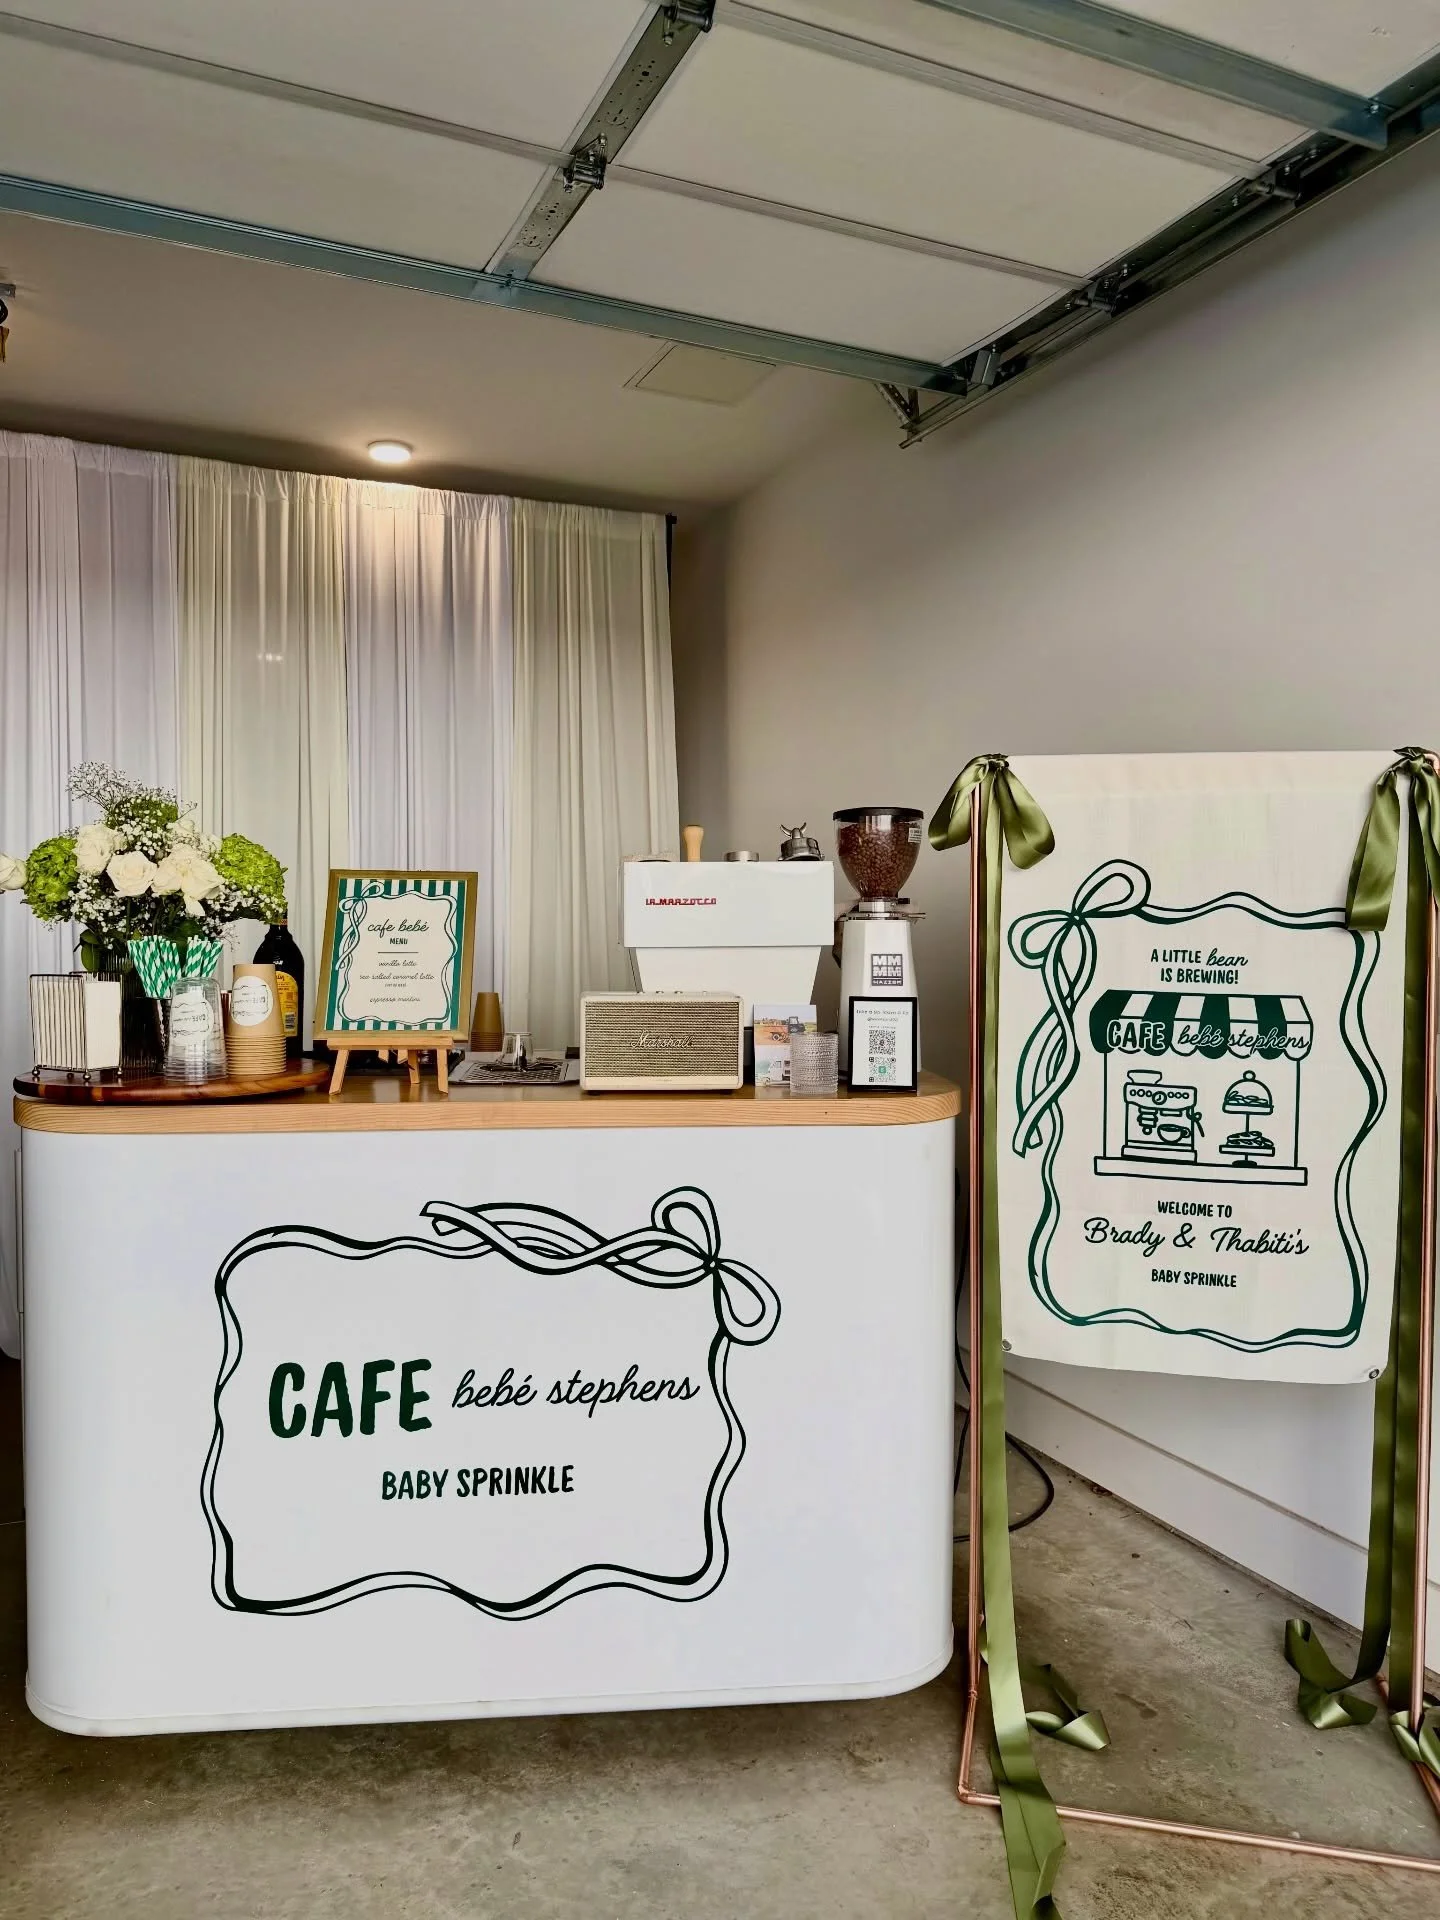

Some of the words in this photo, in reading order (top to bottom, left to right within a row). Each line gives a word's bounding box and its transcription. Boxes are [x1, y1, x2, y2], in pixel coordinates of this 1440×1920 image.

[367, 918, 396, 939] cafe
[397, 919, 430, 932] bebé
[389, 937, 409, 945] MENU
[378, 959, 400, 967] vanilla
[402, 959, 417, 967] latte
[1150, 948, 1159, 963] A
[1162, 949, 1202, 964] LITTLE
[1205, 947, 1249, 967] bean
[371, 972, 391, 980] salted
[392, 972, 418, 980] caramel
[419, 972, 435, 980] latte
[1160, 967, 1173, 983] IS
[1176, 967, 1239, 985] BREWING!
[629, 1030, 695, 1049] Marshall
[1108, 1020, 1165, 1049] CAFE
[1178, 1025, 1224, 1047] bebé
[1228, 1027, 1310, 1054] stephens
[1157, 1200, 1214, 1217] WELCOME
[1216, 1204, 1233, 1219] TO
[1083, 1216, 1166, 1258] Brady
[1172, 1222, 1196, 1249] &
[1210, 1226, 1310, 1255] Thabiti's
[1151, 1268, 1182, 1284] BABY
[1183, 1271, 1237, 1288] SPRINKLE
[268, 1358, 433, 1439] CAFE
[451, 1367, 538, 1409] bebé
[545, 1363, 701, 1419] stephens
[381, 1468, 449, 1501] BABY
[456, 1464, 575, 1498] SPRINKLE
